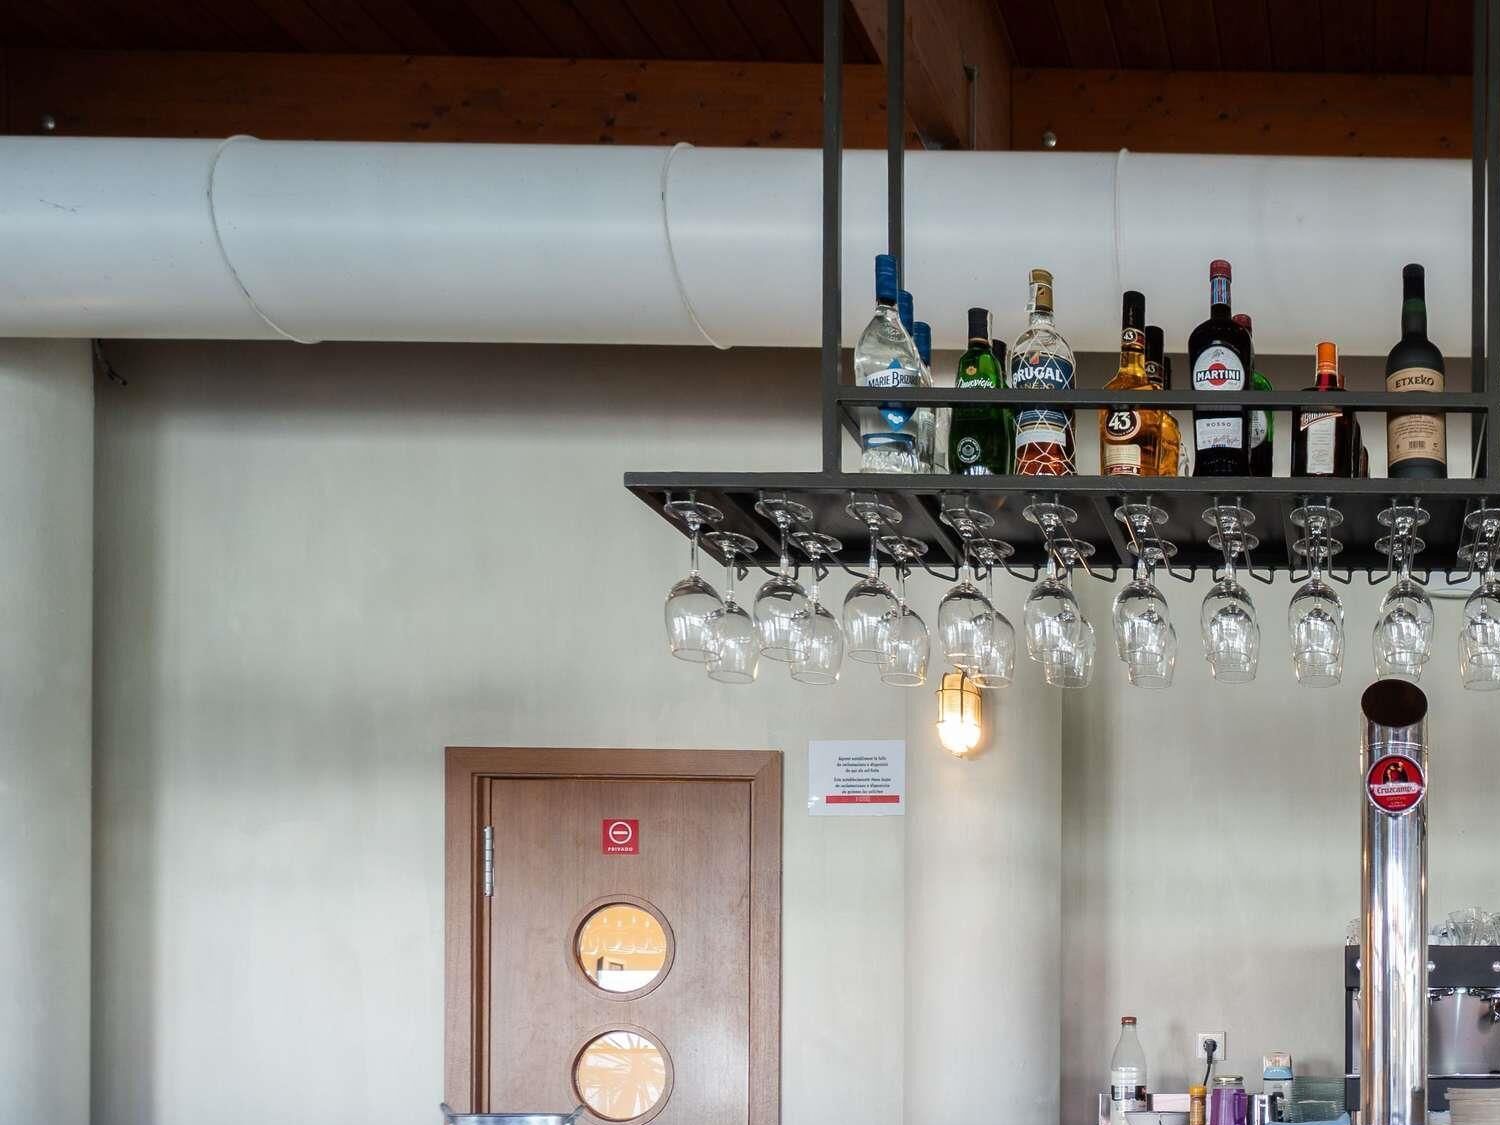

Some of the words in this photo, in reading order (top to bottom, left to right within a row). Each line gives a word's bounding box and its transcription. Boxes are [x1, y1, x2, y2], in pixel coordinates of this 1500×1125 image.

[1124, 331, 1134, 340] 43
[868, 375, 891, 388] MARIE
[1013, 366, 1063, 386] BRUGAL
[1197, 370, 1240, 382] MARTINI
[1395, 374, 1435, 388] ETXEKO
[1108, 411, 1132, 430] 43
